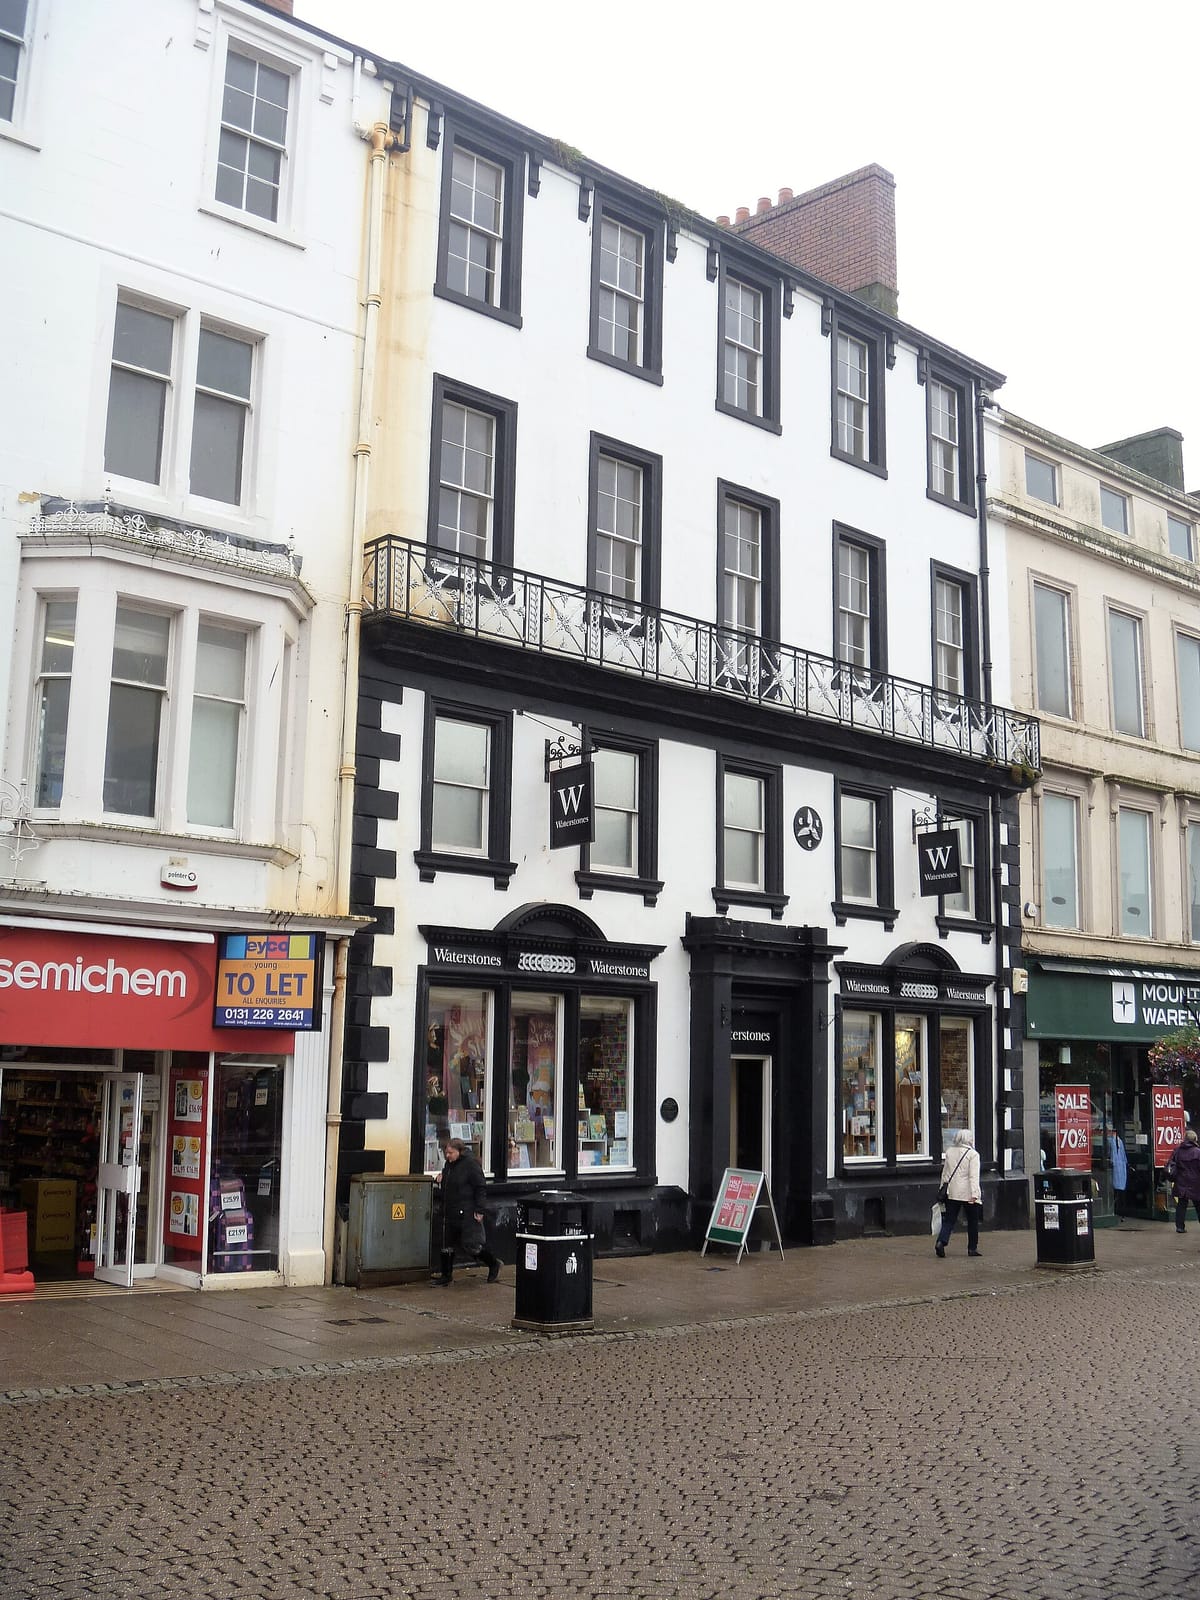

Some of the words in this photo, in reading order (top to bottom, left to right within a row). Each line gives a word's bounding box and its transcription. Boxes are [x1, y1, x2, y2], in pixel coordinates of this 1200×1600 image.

[557, 784, 585, 815] W
[555, 816, 589, 829] Waterstones
[925, 845, 953, 871] W
[924, 872, 958, 881] Waterstones
[247, 941, 289, 954] eyco
[254, 962, 278, 970] young
[434, 948, 502, 967] Waterstones
[589, 959, 648, 977] Waterstones
[0, 956, 187, 998] semichem
[224, 972, 255, 995] TO
[265, 973, 308, 996] LET
[846, 980, 890, 994] Waterstones
[946, 987, 985, 1000] Waterstones
[225, 1008, 249, 1019] 0131
[252, 1009, 273, 1020] 226
[277, 1009, 304, 1020] 2641
[1142, 1007, 1200, 1027] WAREH
[1057, 1093, 1088, 1110] SALE
[1155, 1093, 1182, 1109] SALE
[1059, 1128, 1087, 1149] 70%
[1157, 1127, 1182, 1145] 70%
[228, 1229, 246, 1237] £21.99
